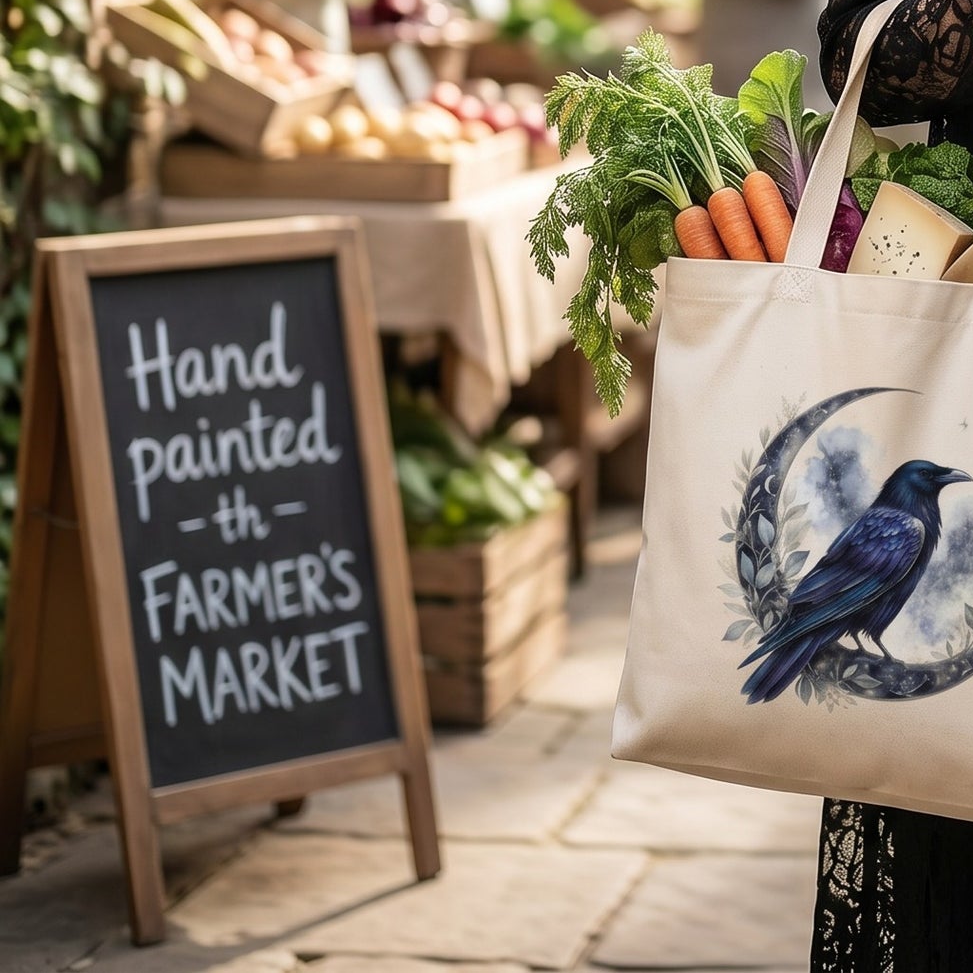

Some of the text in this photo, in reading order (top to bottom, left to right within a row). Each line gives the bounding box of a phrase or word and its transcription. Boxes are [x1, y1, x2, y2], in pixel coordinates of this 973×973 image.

[126, 301, 303, 412] Hand
[127, 382, 342, 522] painted
[140, 542, 363, 643] FARMER'S
[158, 621, 369, 727] MARKET
